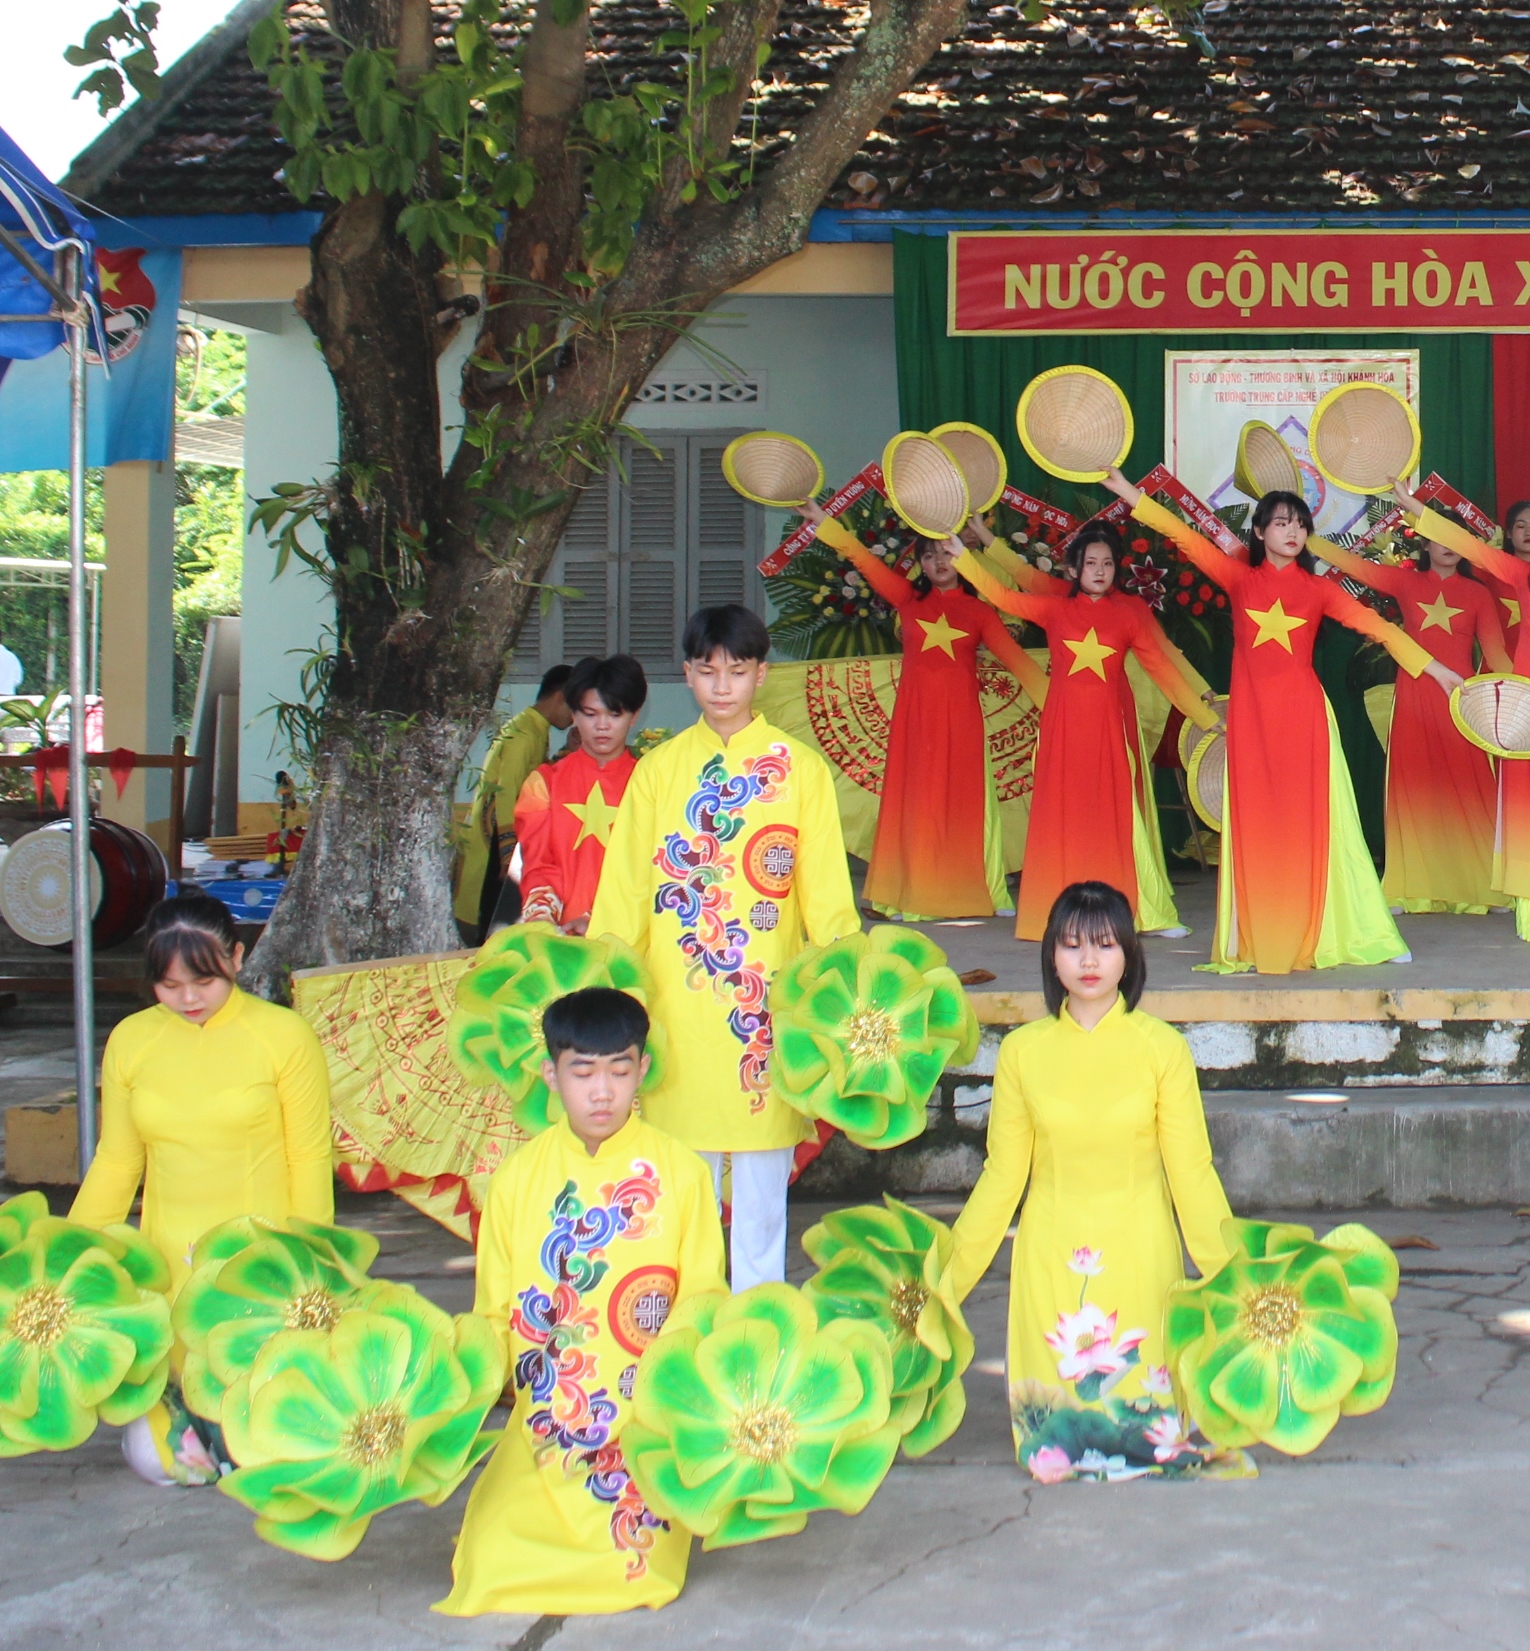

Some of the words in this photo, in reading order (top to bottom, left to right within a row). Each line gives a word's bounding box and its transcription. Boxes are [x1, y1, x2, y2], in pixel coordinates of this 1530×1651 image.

[1004, 250, 1166, 310] NƯỚC
[1186, 249, 1349, 317] CỘNG
[1371, 248, 1494, 307] HÒA
[1201, 372, 1217, 384] LAO
[1283, 371, 1303, 384] BINH
[1304, 369, 1316, 384] VÀ
[1347, 369, 1376, 383] KHÁNH
[1248, 391, 1276, 403] TRUNG
